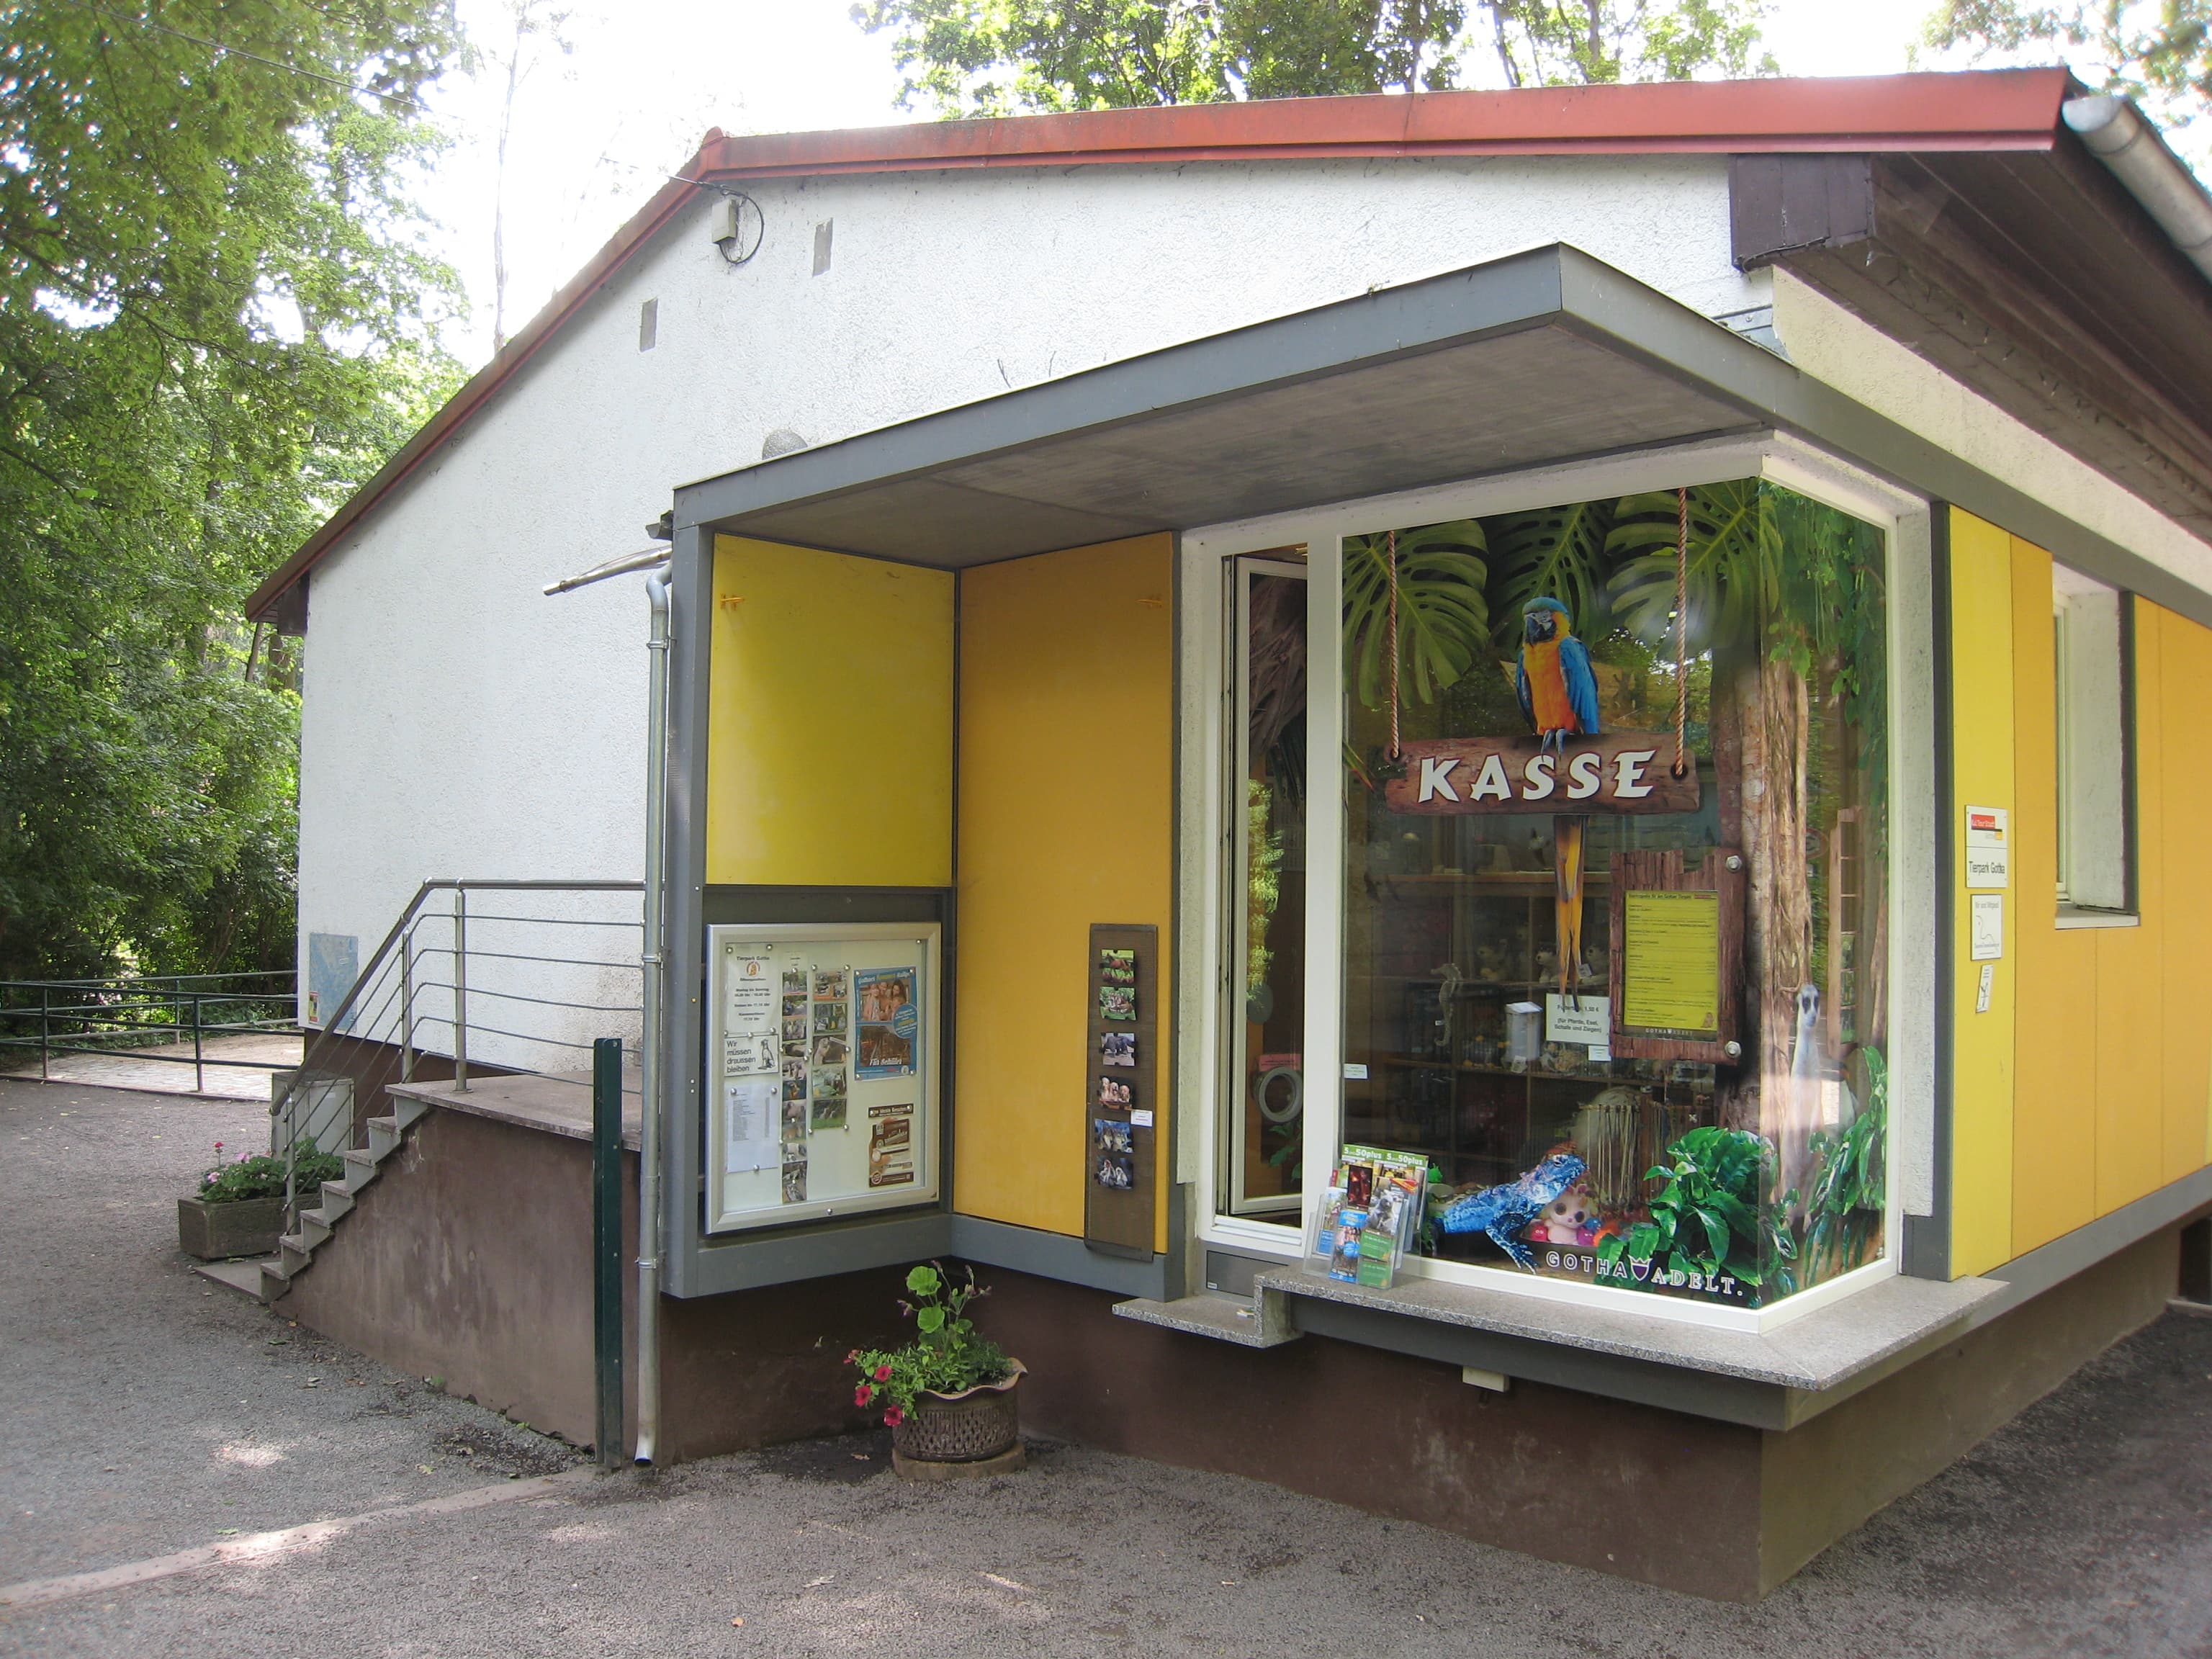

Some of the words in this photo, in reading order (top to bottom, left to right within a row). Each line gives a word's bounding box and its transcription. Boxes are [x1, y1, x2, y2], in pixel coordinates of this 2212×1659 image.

[1417, 749, 1657, 804] KASSE
[1969, 861, 1990, 876] Tierpark
[1990, 862, 2005, 874] Gotha
[1545, 1251, 1628, 1279] GOTHA
[1651, 1267, 1744, 1297] ADELT.
